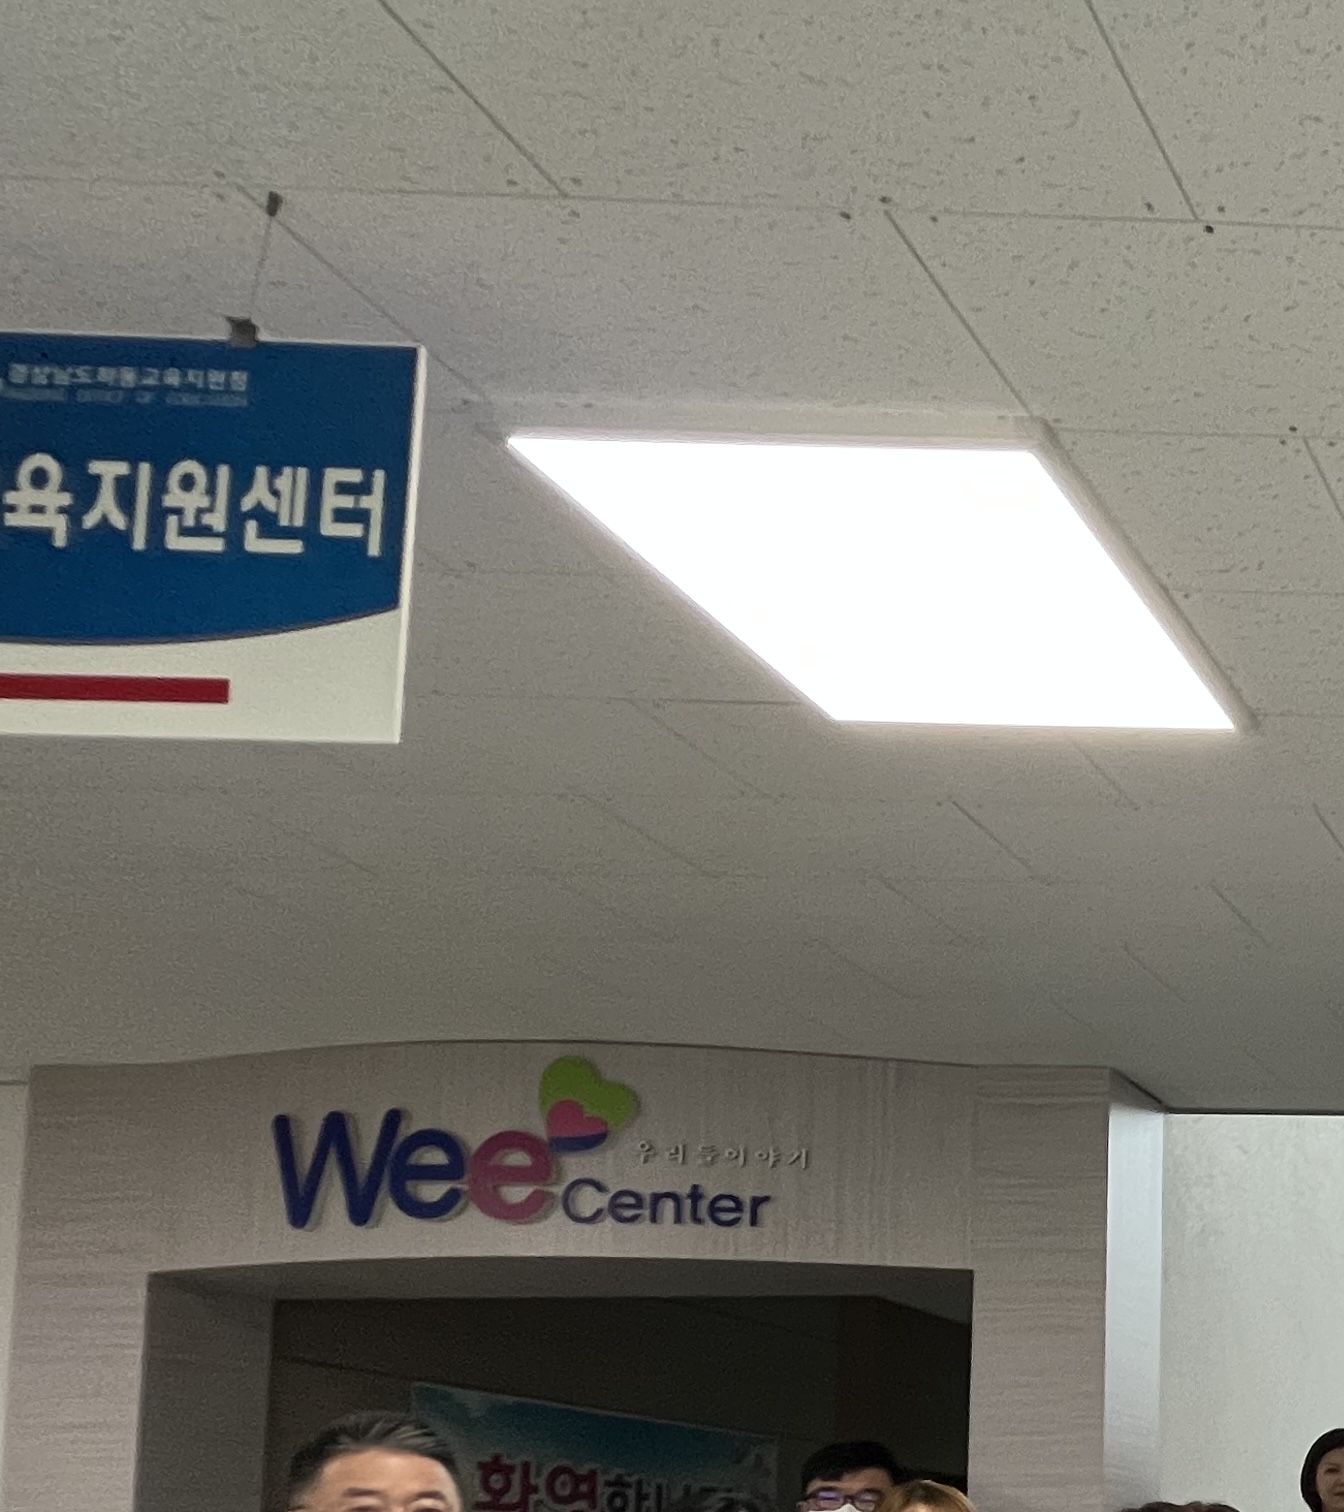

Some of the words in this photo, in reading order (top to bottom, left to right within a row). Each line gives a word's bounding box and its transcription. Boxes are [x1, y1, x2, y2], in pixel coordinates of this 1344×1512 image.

[3, 452, 386, 558] 육지원센터
[272, 1108, 555, 1229] Wee
[562, 1178, 772, 1227] Center
